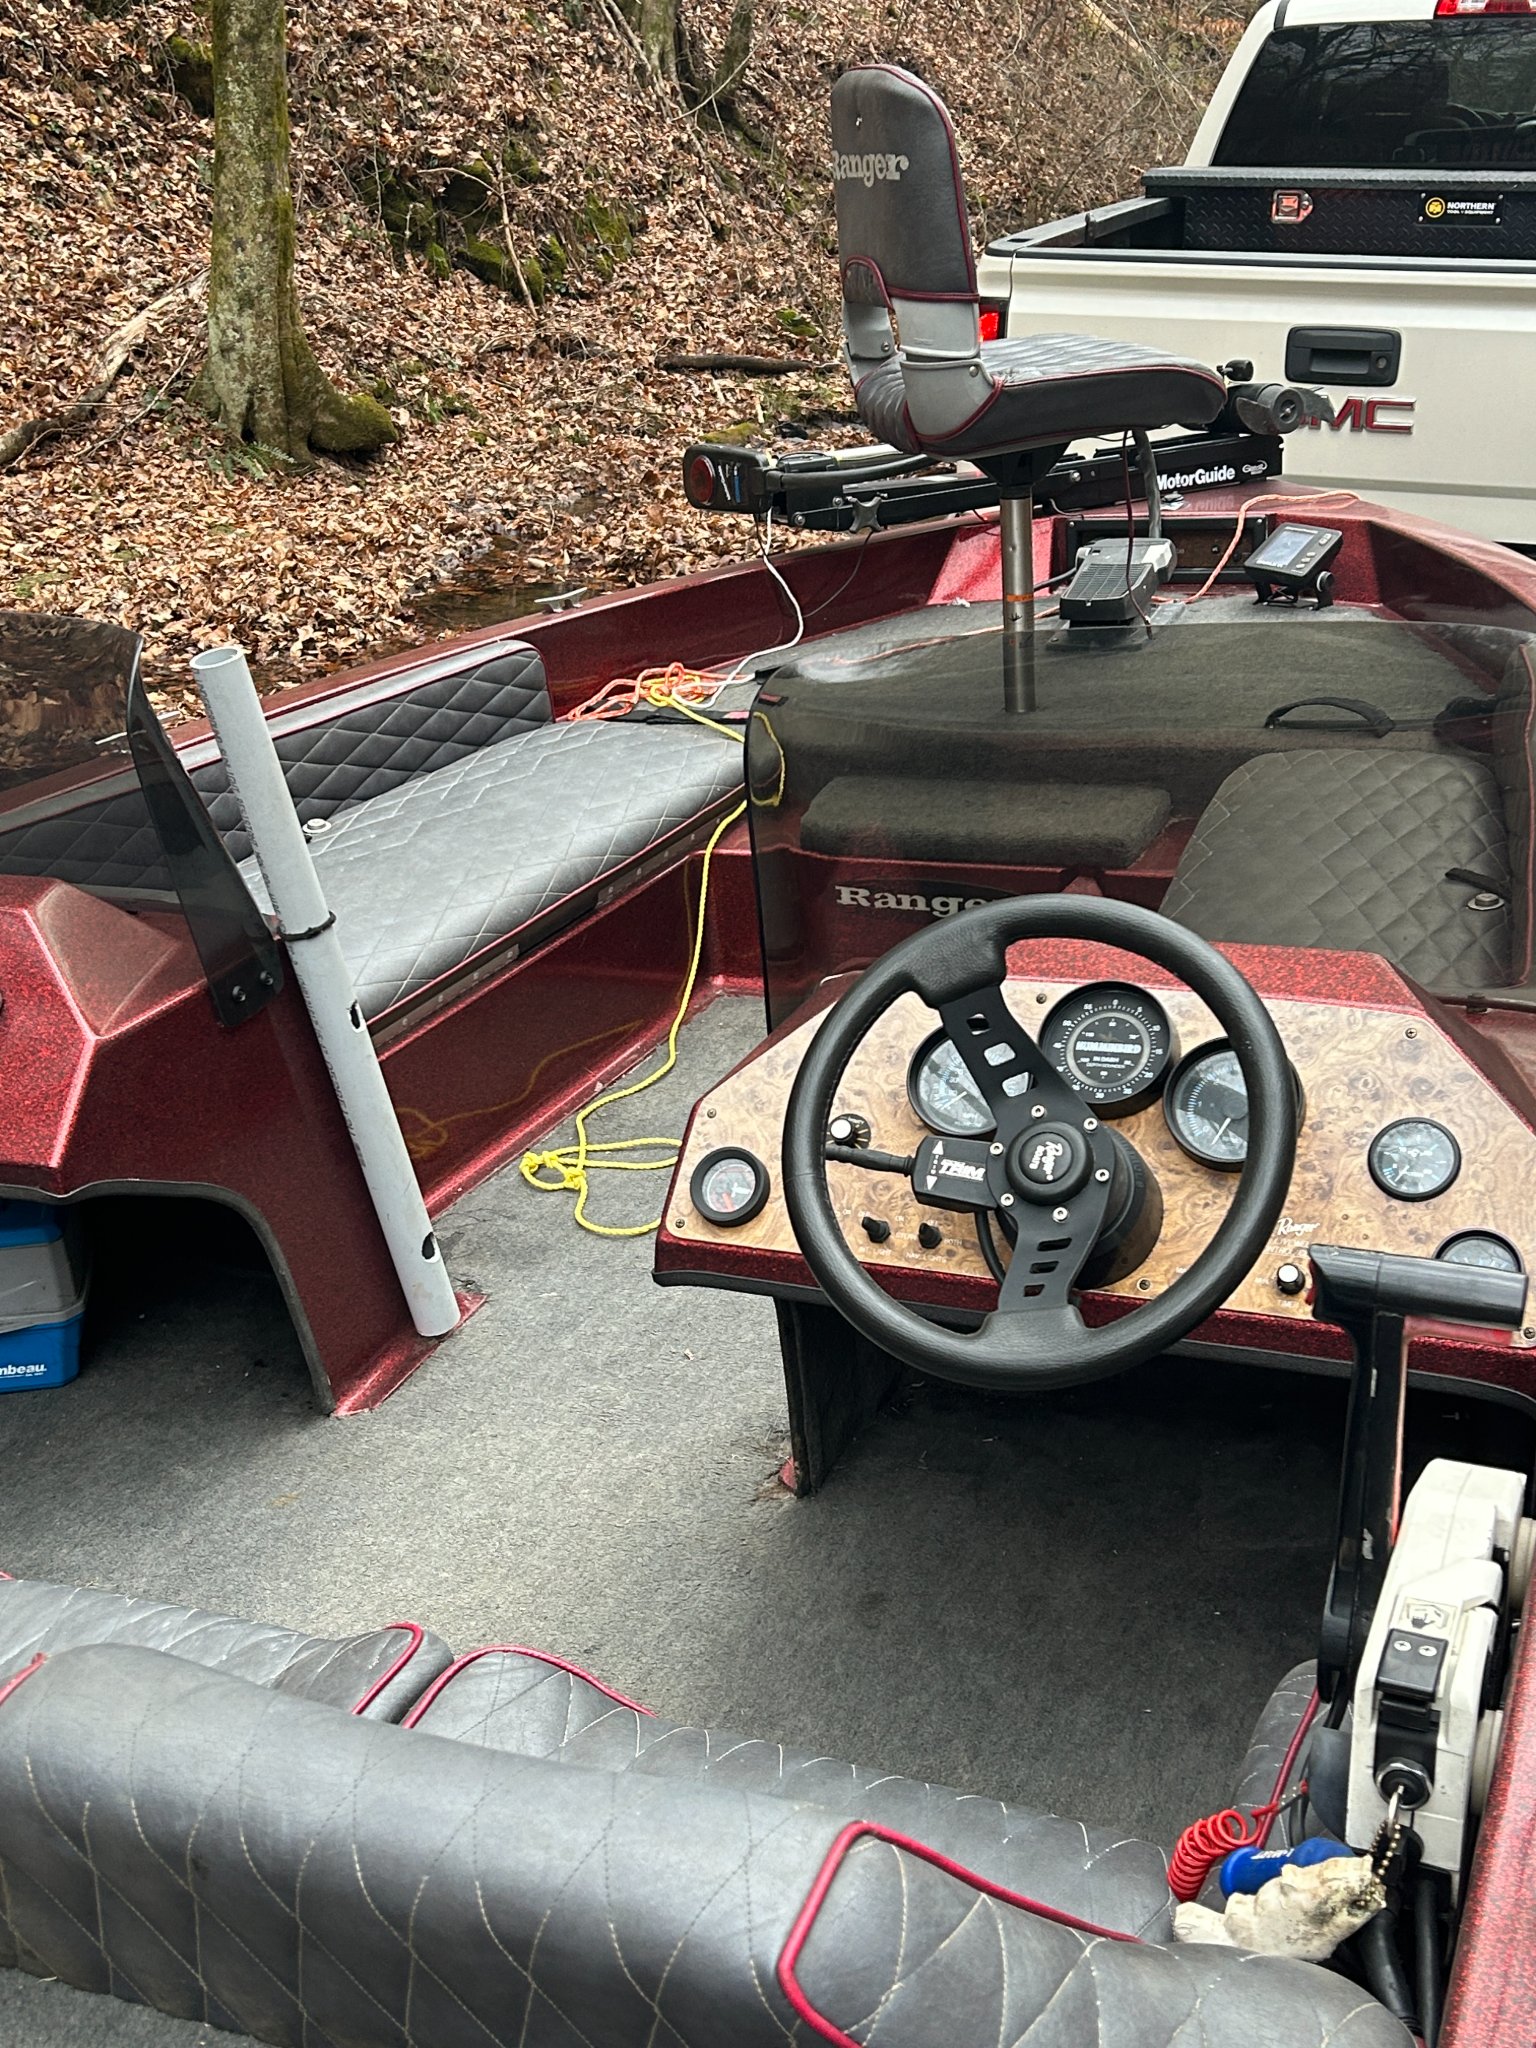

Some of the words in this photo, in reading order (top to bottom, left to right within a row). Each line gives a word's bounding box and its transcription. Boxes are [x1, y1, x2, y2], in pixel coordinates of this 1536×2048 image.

[831, 150, 909, 188] Ranger
[1447, 202, 1495, 210] NORTHERN
[1299, 396, 1416, 435] MC
[1157, 465, 1236, 490] MotorGuide
[835, 886, 994, 918] Range
[939, 1160, 986, 1181] TRIM
[1277, 1217, 1321, 1236] Ranger
